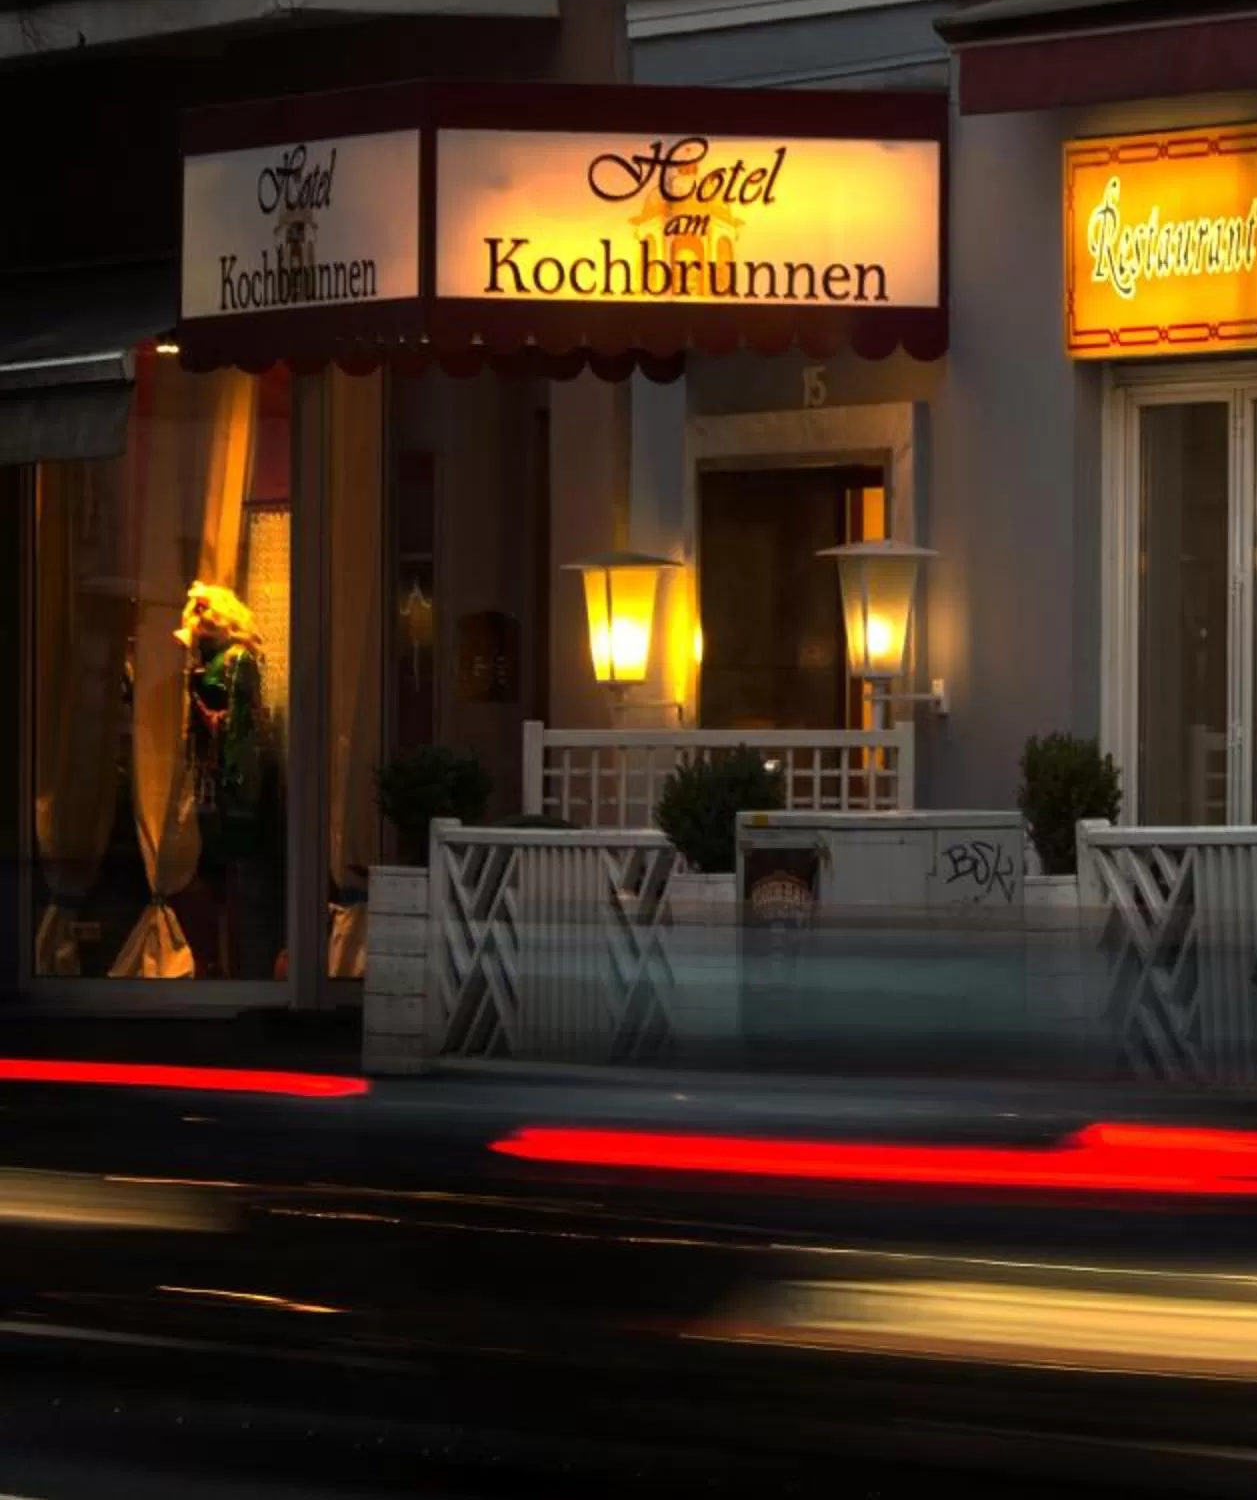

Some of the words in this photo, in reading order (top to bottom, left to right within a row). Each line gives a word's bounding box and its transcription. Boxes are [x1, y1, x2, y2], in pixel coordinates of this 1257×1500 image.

[258, 144, 336, 215] Hotel
[587, 136, 787, 205] Hotel
[662, 213, 711, 238] am
[220, 244, 377, 310] Kochbrunnen
[483, 238, 889, 302] Kochbrunnen
